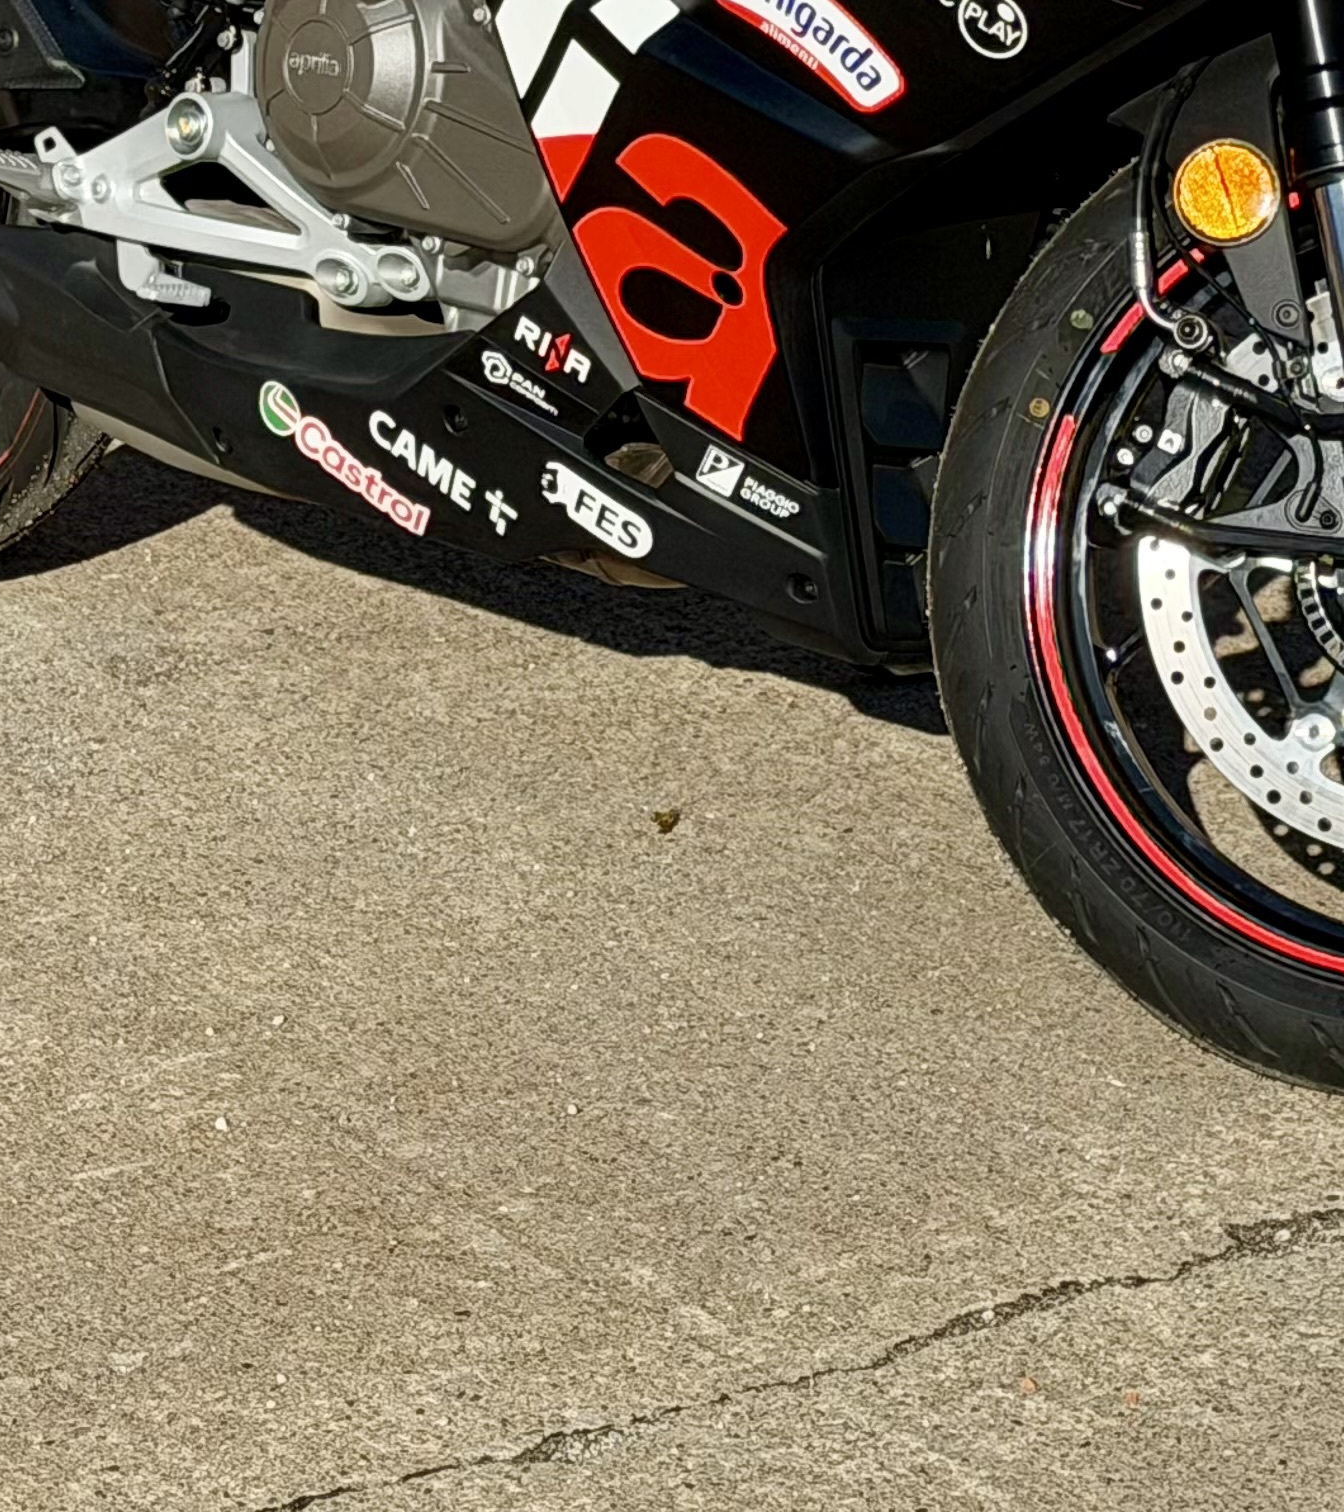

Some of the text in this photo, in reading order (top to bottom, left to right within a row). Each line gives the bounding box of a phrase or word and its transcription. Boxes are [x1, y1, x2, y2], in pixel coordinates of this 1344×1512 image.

[964, 2, 1022, 46] PLAY
[298, 419, 428, 533] Castrol
[368, 410, 476, 512] CAME
[739, 487, 790, 518] GROUP
[743, 476, 800, 515] PIAGGIO
